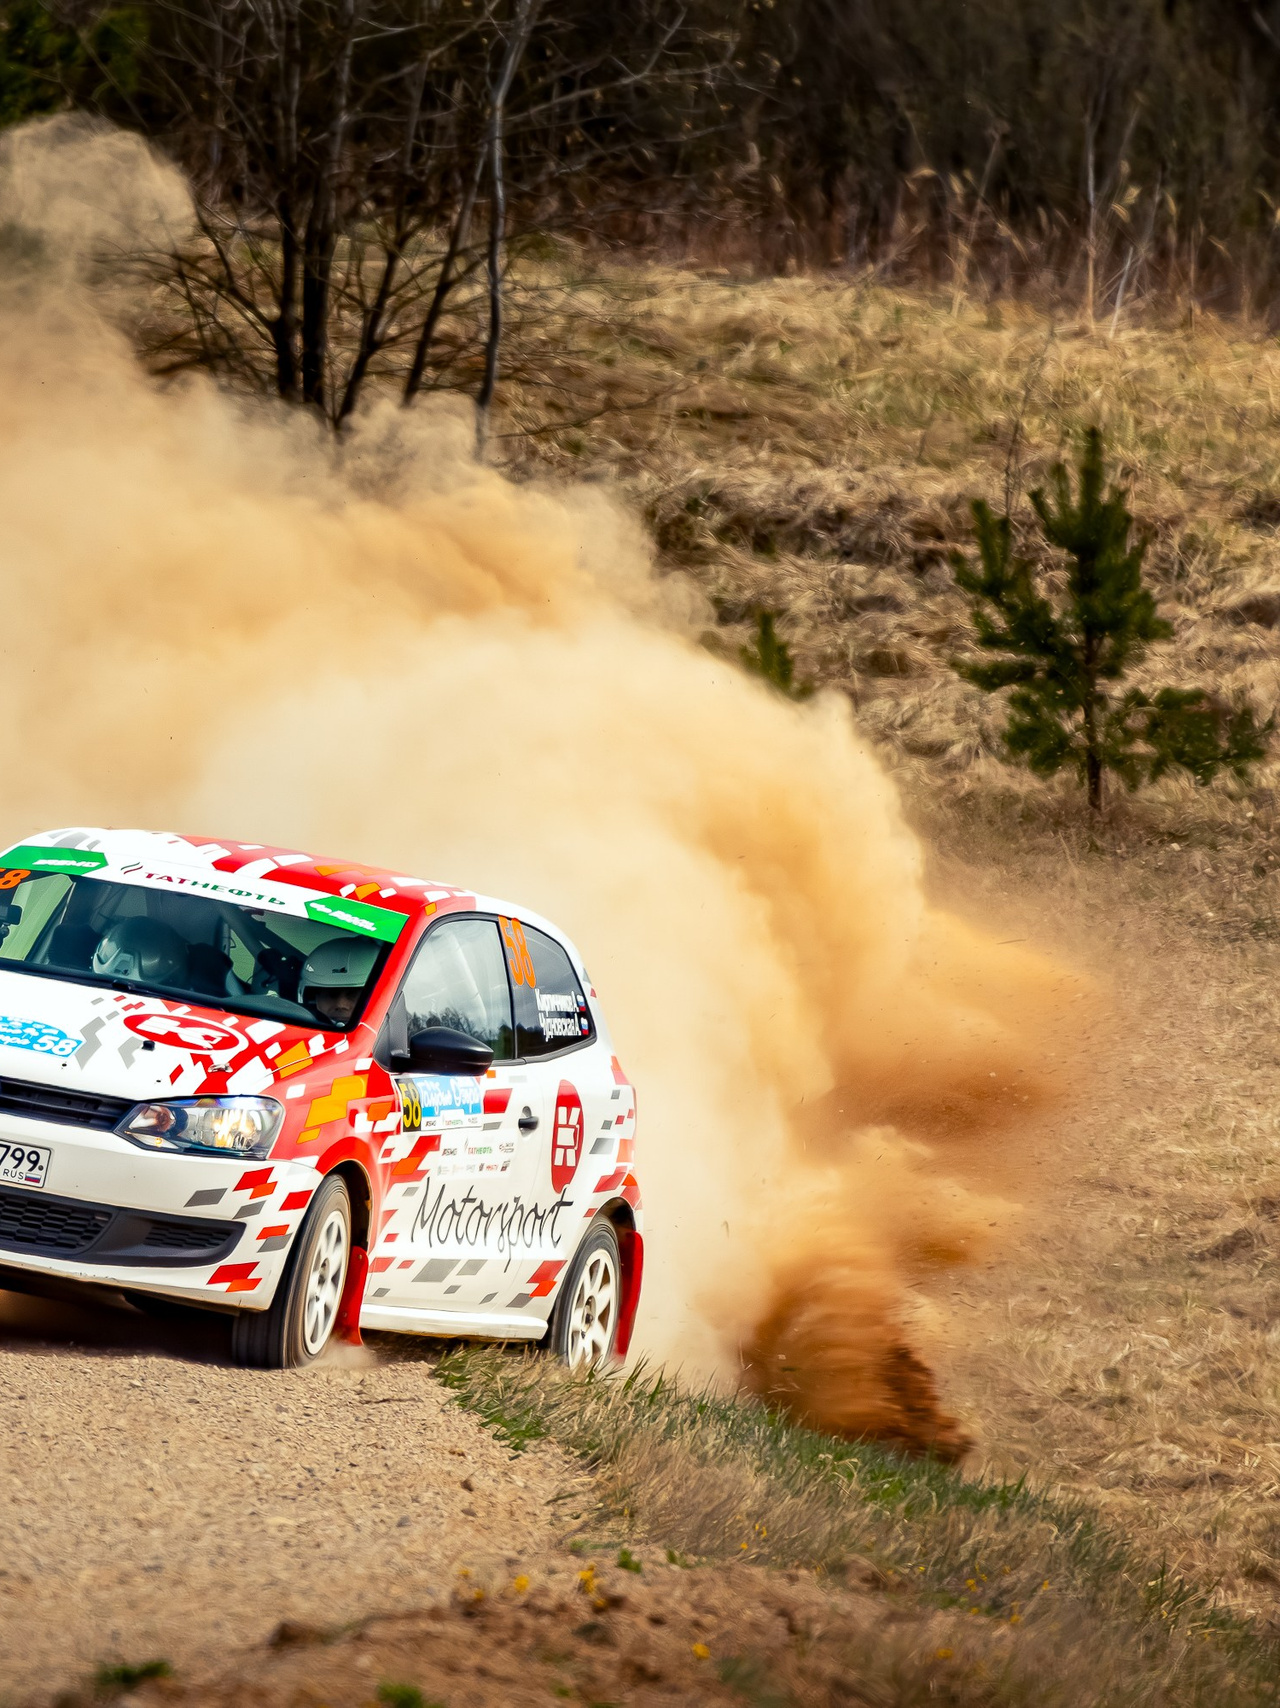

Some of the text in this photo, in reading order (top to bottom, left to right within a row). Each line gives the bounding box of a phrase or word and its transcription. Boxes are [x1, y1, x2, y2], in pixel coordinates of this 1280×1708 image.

[144, 872, 286, 906] ТАТНЕФТЬ
[498, 915, 536, 988] 58
[33, 1035, 77, 1056] 58
[398, 1082, 422, 1128] 58
[3, 1168, 24, 1180] RUS
[410, 1177, 574, 1273] Motorsport
